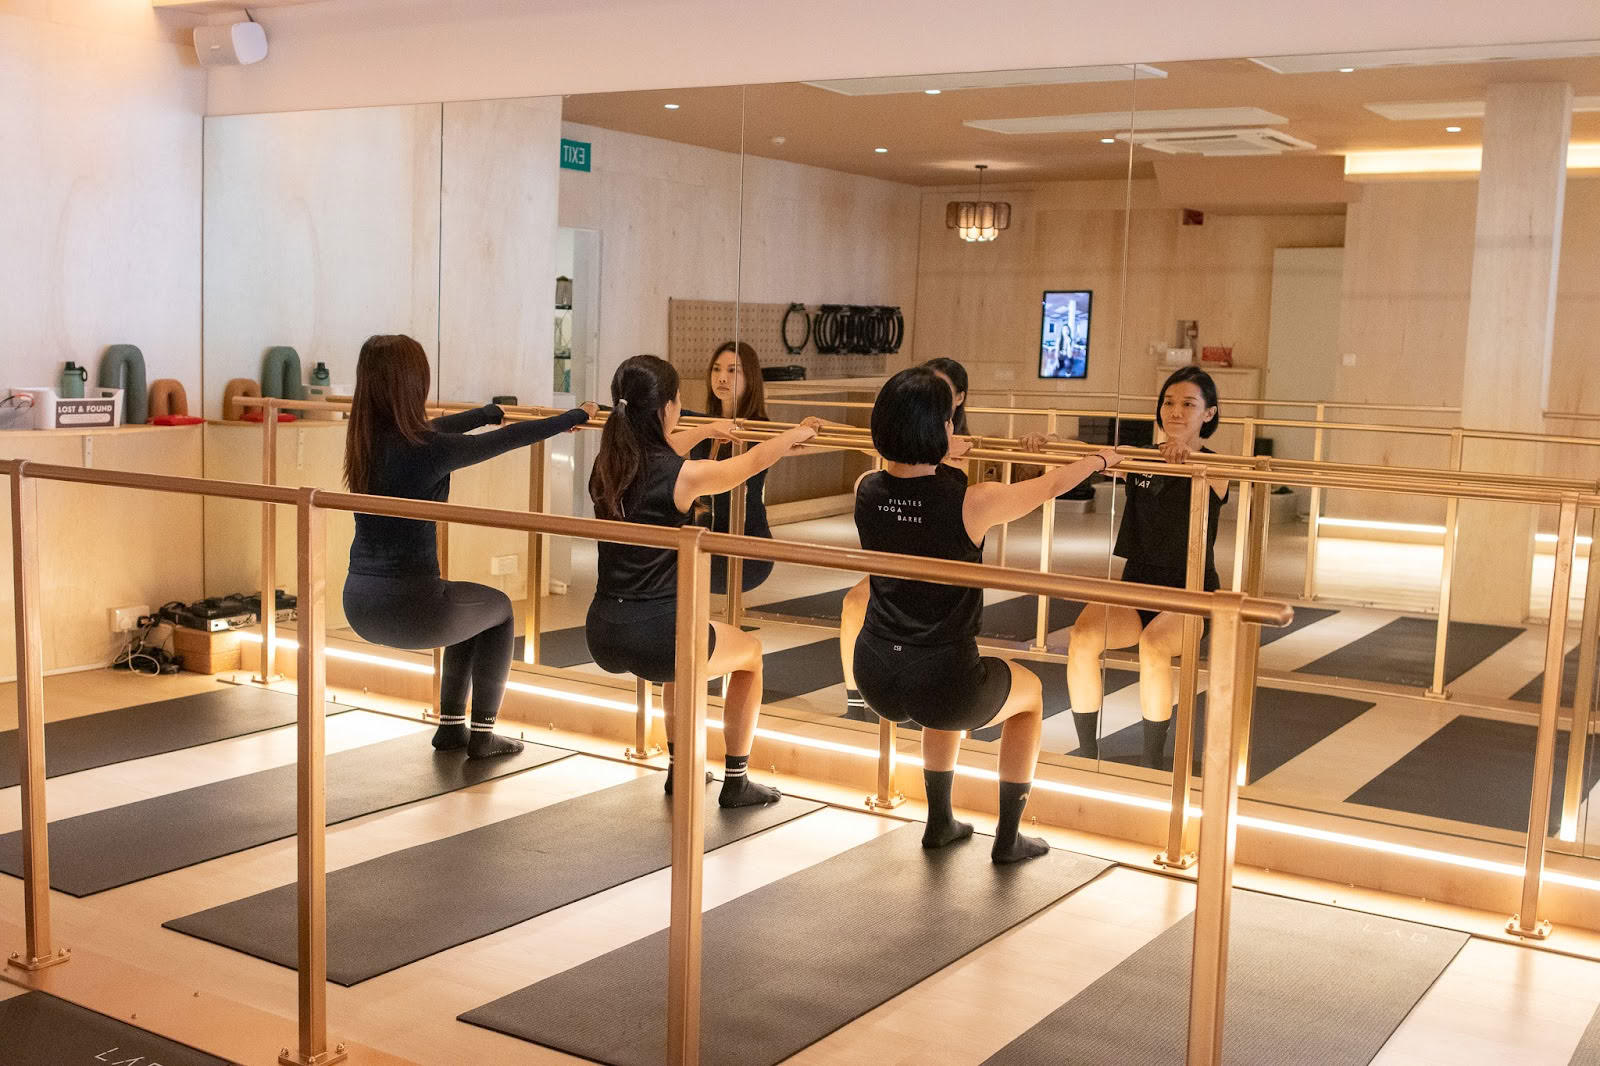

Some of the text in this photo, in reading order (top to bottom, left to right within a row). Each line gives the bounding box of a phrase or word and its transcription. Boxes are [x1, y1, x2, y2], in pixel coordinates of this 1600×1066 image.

[58, 404, 113, 413] LOST & FOUND
[888, 498, 922, 507] PILATES
[877, 505, 903, 513] YOGA
[897, 514, 923, 524] BARRE
[94, 1047, 164, 1066] LA
